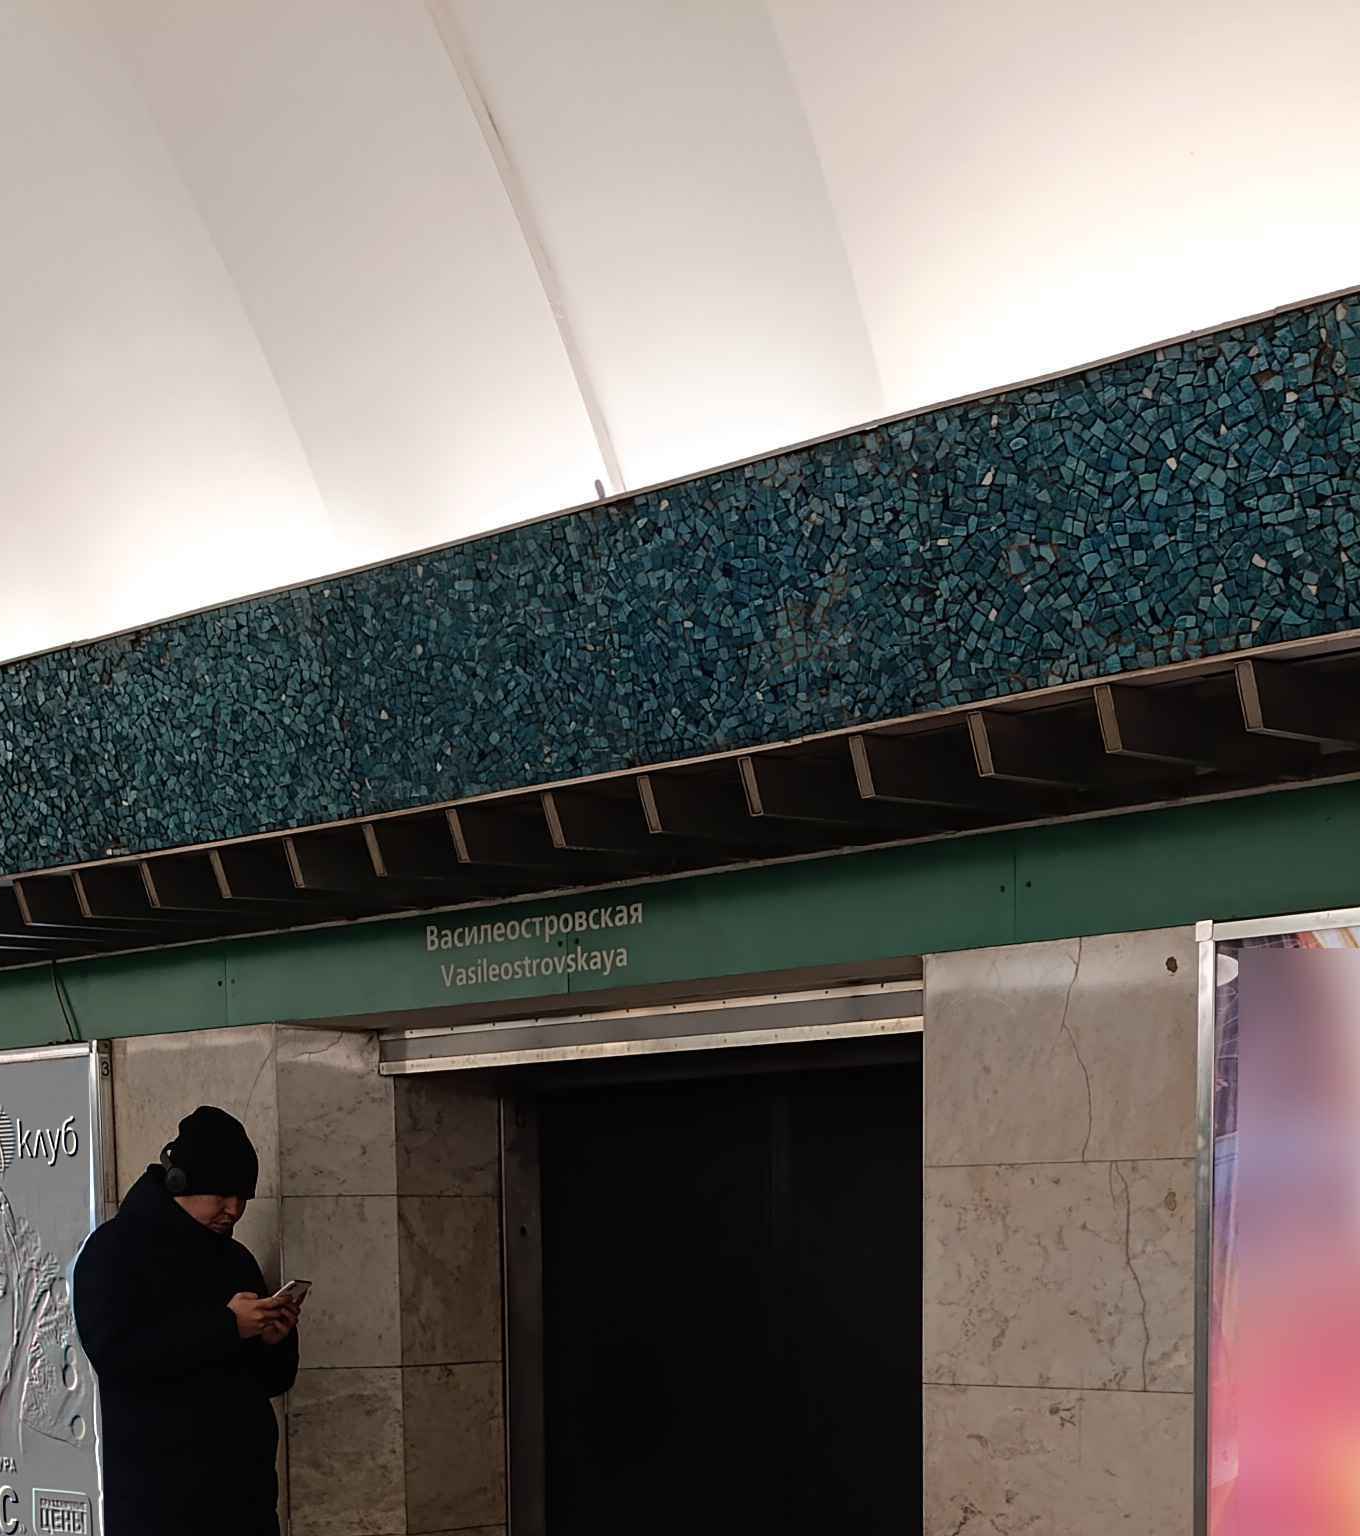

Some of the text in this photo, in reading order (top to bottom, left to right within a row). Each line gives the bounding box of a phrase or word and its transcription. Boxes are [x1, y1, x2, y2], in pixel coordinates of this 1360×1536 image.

[426, 903, 643, 951] Василеостровская
[441, 946, 628, 987] Vasileostrovskaya
[15, 1115, 79, 1166] клуб
[40, 1508, 87, 1535] ЦЕНЫ
